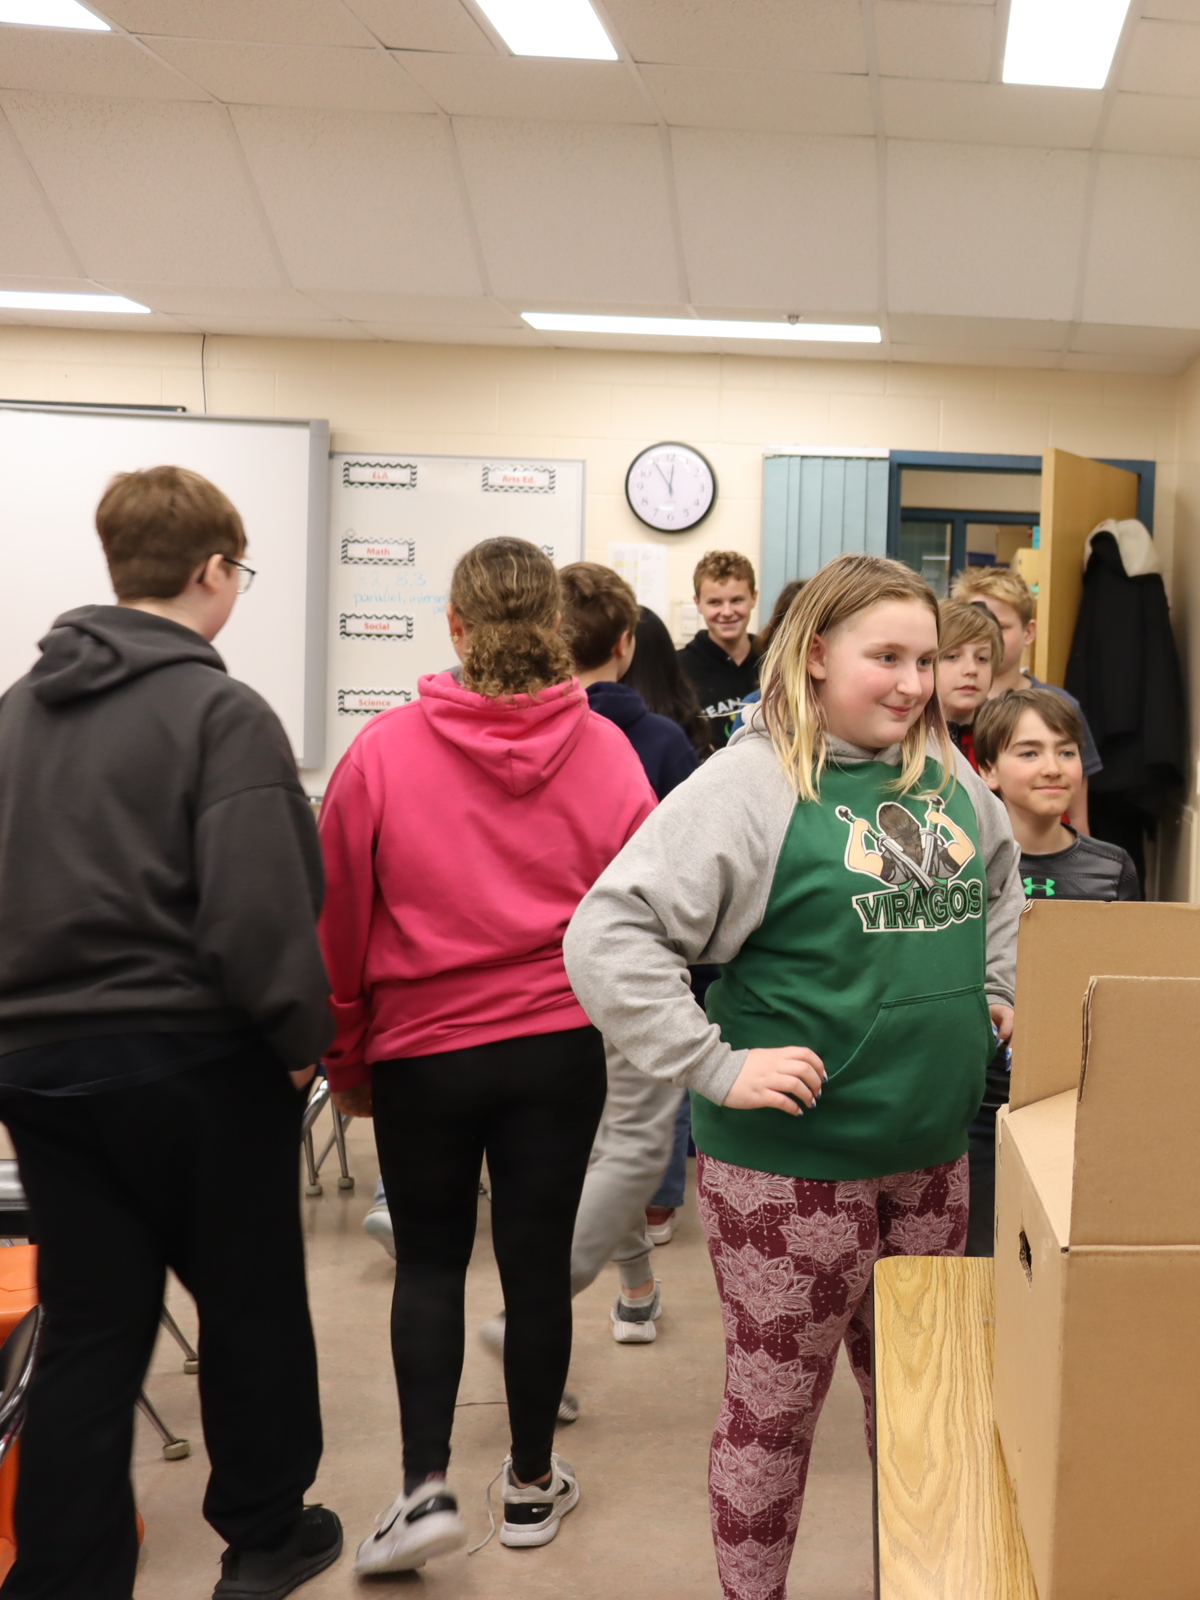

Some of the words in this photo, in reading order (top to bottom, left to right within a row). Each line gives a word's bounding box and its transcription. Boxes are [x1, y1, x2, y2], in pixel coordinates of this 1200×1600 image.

[372, 471, 389, 480] ELA
[502, 475, 521, 484] Arts
[523, 475, 536, 484] Ed.
[367, 547, 390, 556] Math
[364, 622, 390, 631] Social
[358, 698, 392, 707] Science
[855, 881, 983, 930] VIRAGOS
